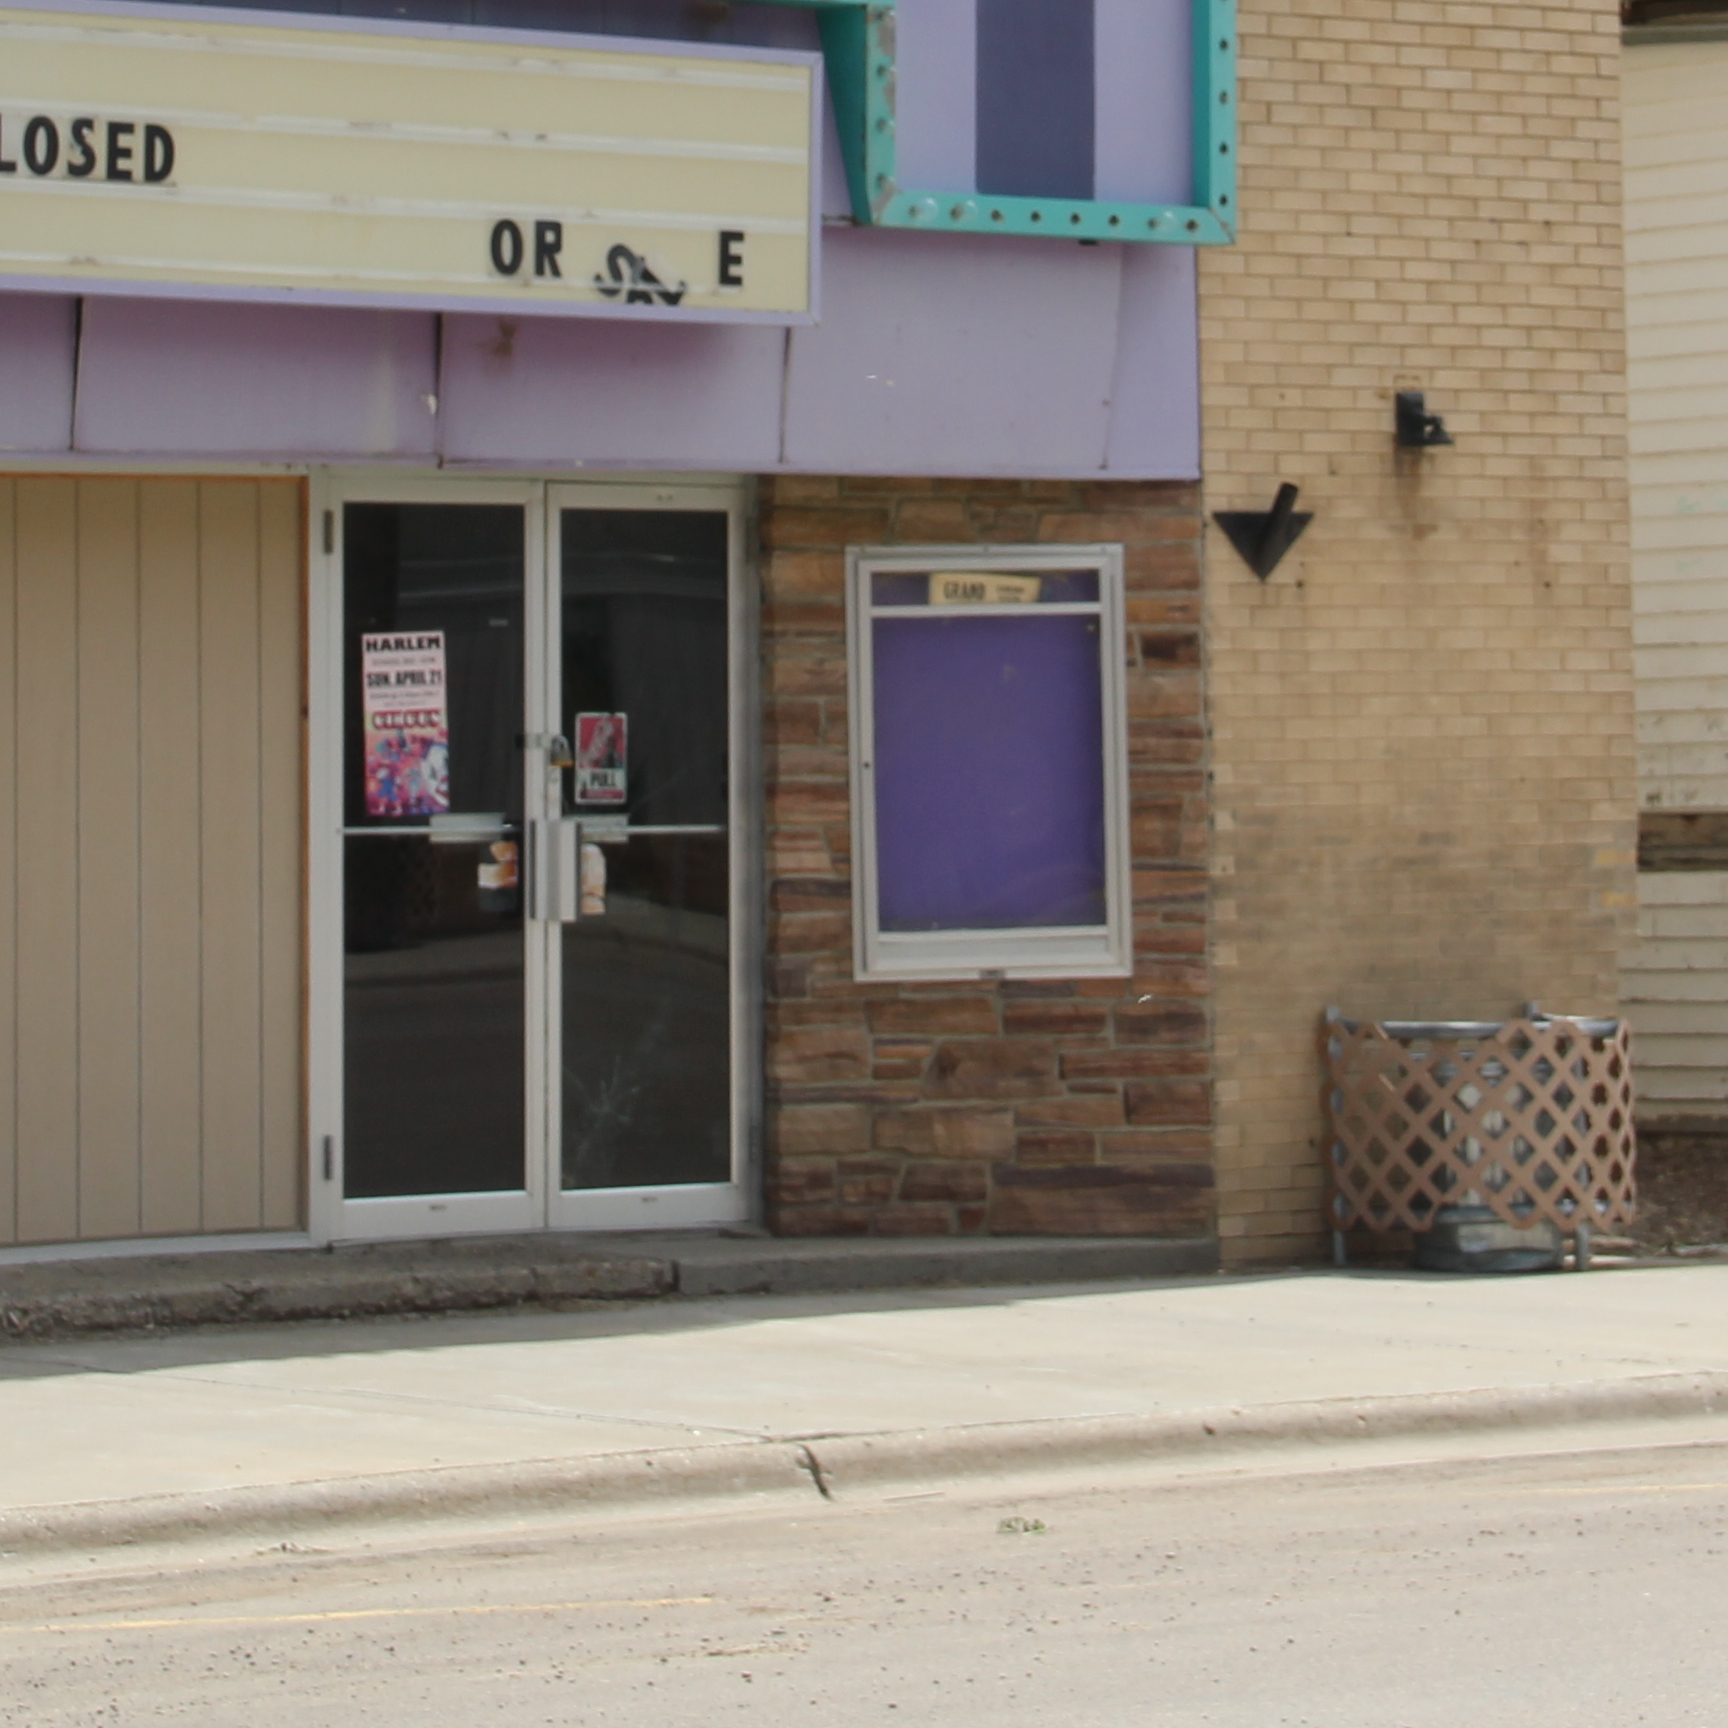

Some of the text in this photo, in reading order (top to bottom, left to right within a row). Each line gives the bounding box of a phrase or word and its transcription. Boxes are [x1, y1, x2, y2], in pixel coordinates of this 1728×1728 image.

[943, 580, 986, 601] GRAND
[366, 635, 441, 652] HARLEM
[395, 670, 427, 686] APRIL
[373, 709, 441, 729] CIRCUS
[591, 772, 616, 788] PULL
